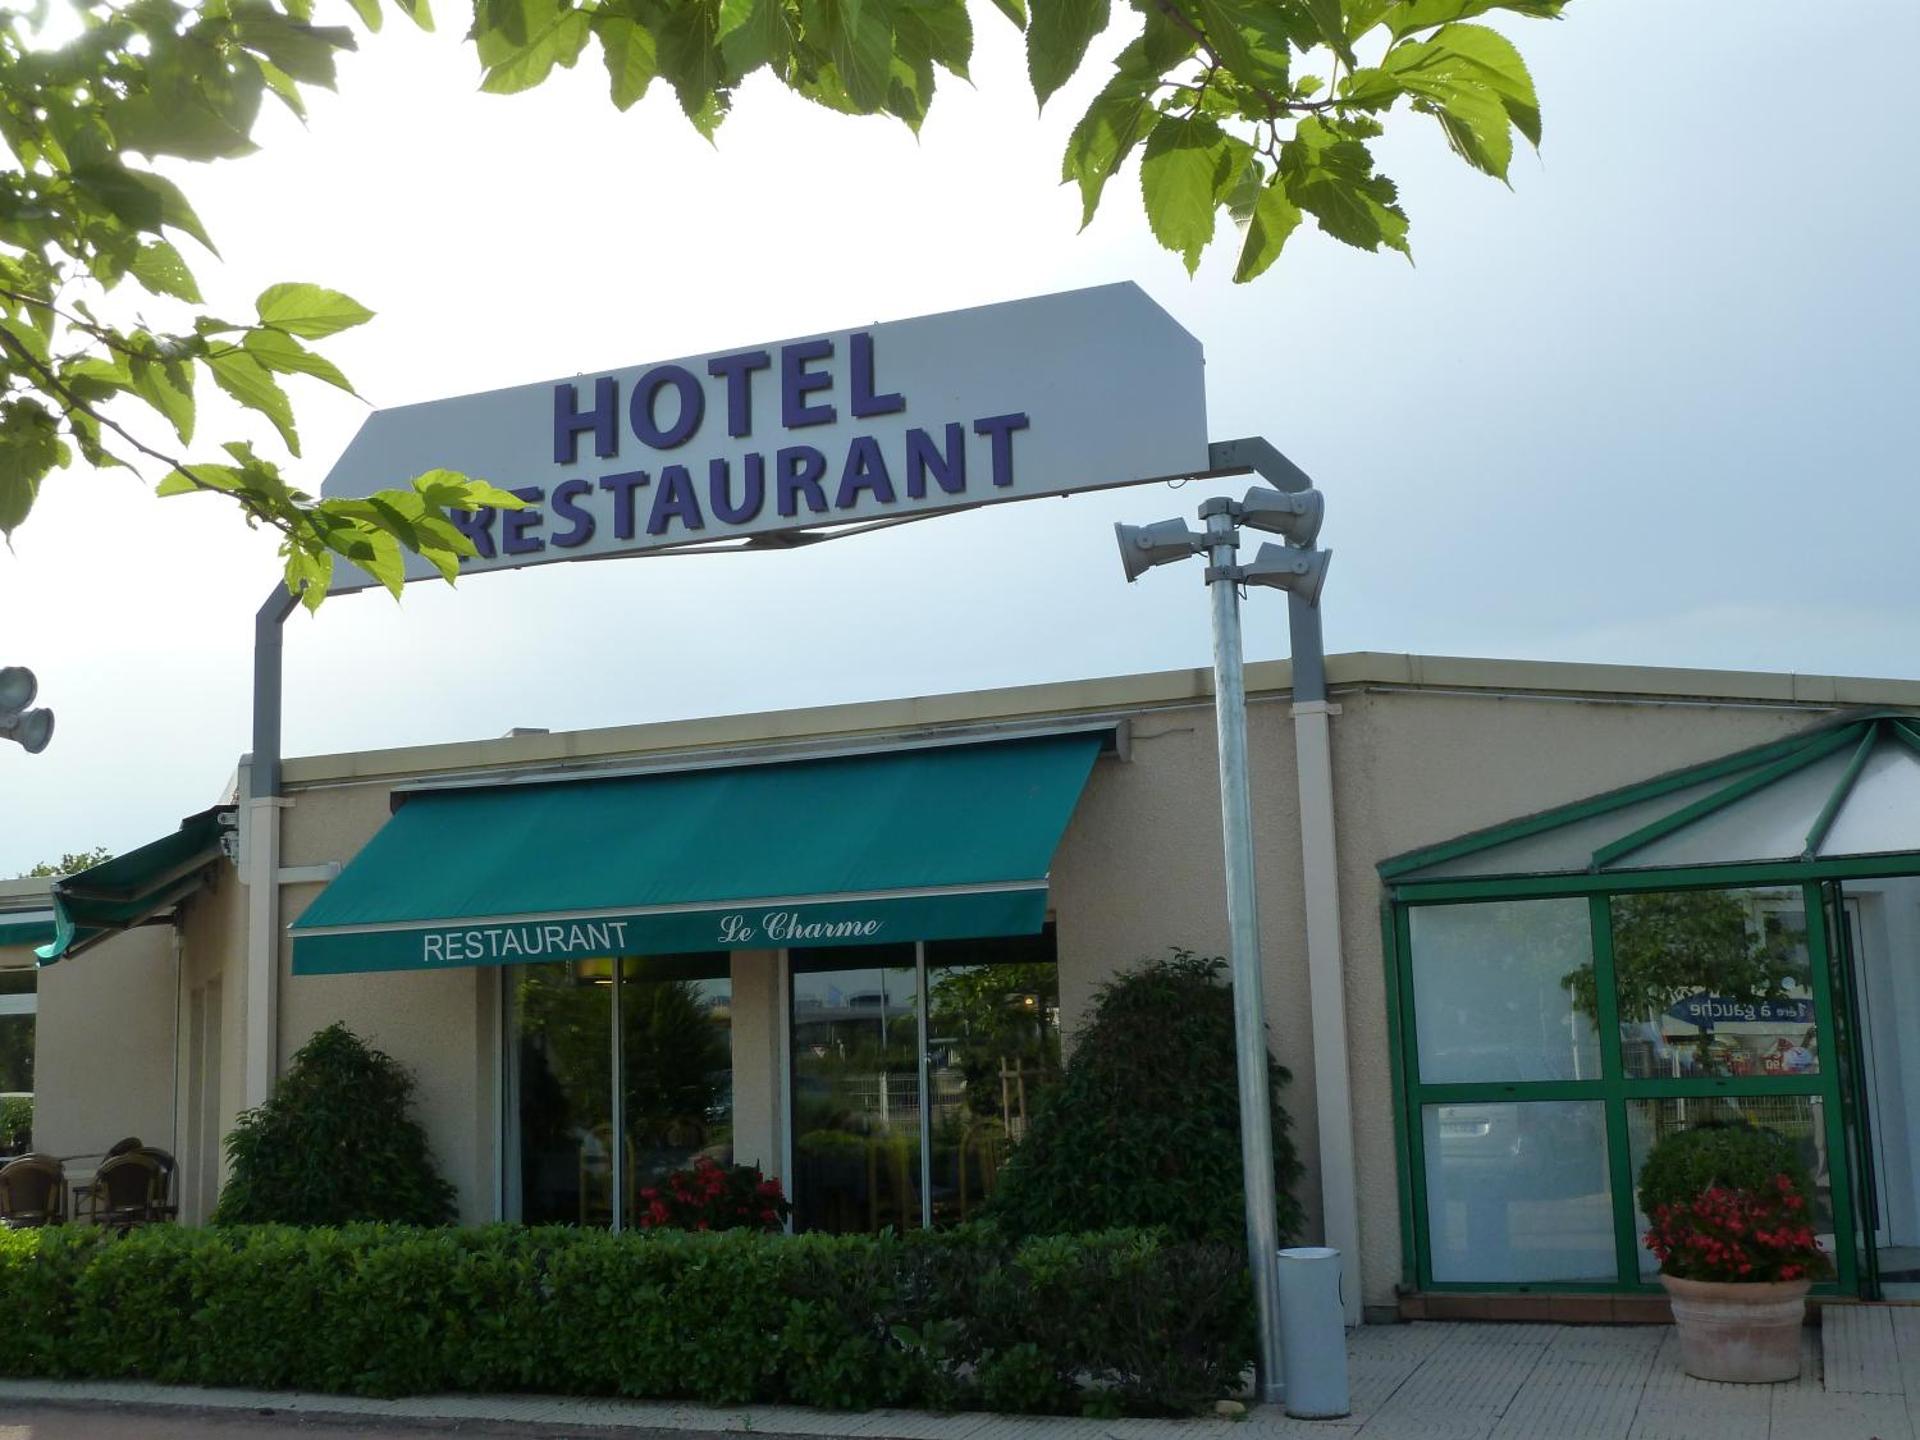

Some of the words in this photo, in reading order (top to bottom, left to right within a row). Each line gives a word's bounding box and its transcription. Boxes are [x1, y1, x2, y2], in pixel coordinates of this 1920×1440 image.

[554, 332, 905, 464] HOTEL
[424, 922, 628, 962] RESTAURANT
[718, 915, 756, 944] Le
[762, 912, 882, 940] Charme
